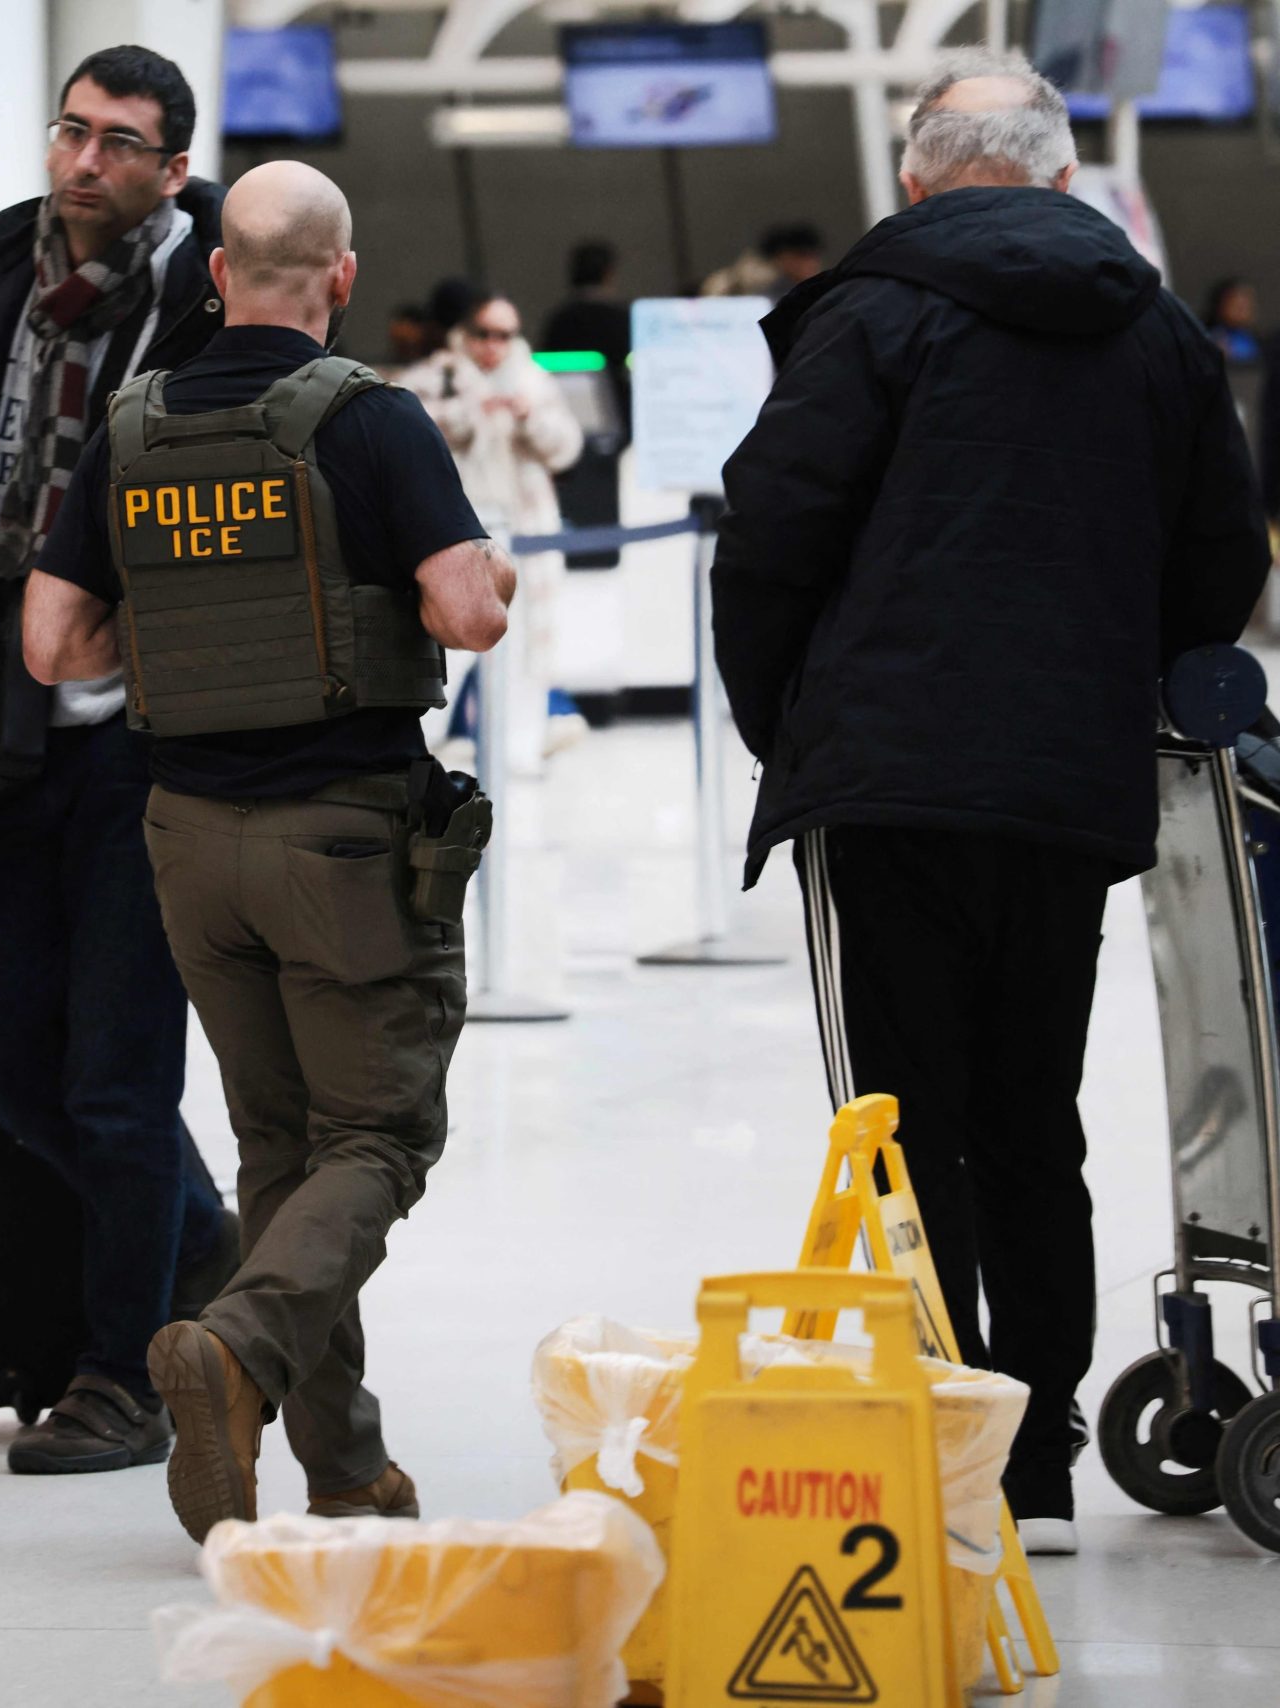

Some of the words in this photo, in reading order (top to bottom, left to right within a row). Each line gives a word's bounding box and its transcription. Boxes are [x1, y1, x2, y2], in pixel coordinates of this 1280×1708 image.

[125, 479, 288, 528] POLICE
[173, 526, 243, 558] ICE
[736, 1466, 883, 1521] CAUTION
[839, 1522, 904, 1611] 2
